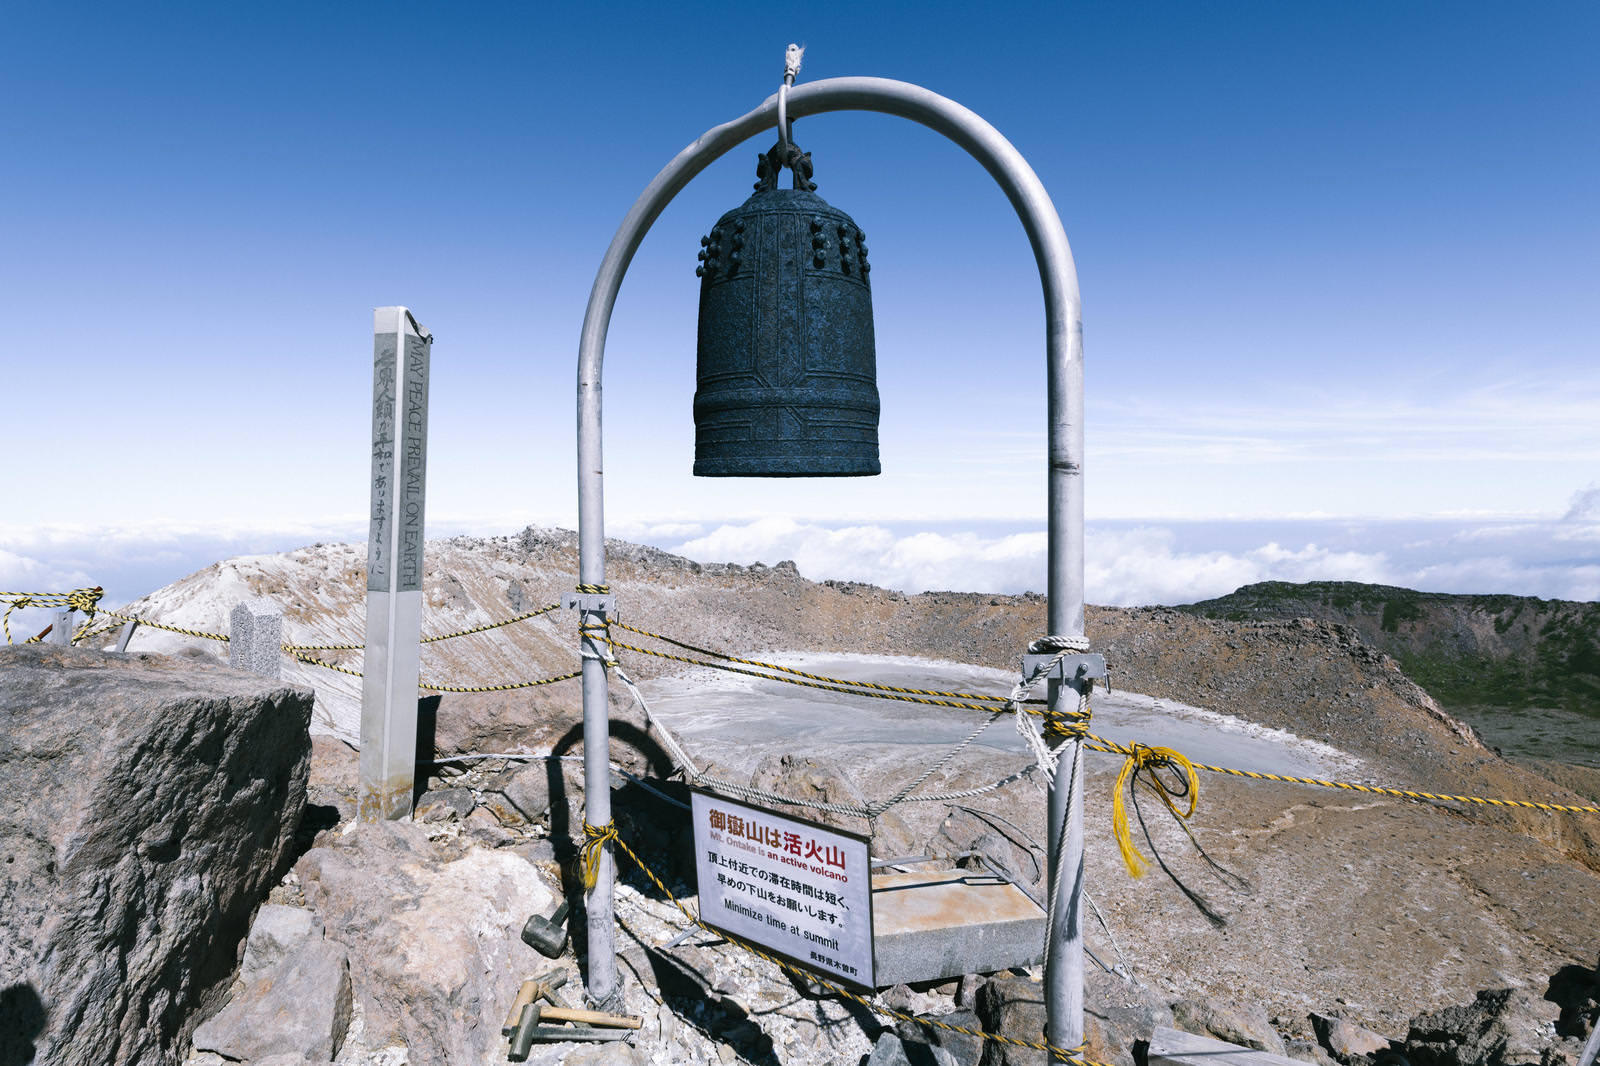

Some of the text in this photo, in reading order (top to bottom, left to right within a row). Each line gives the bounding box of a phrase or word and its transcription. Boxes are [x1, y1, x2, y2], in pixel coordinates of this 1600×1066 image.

[403, 340, 425, 586] MAY PEACE PREVAIL ON EARTH
[709, 808, 846, 870] 御嶽山は活火山
[710, 831, 848, 883] Mt. Ontake is an active volcano
[708, 851, 850, 910] 頂上付近での滞在時間は短く、
[717, 872, 843, 928] 早めの下山をお願いします。
[724, 898, 840, 951] Minimize time at summit
